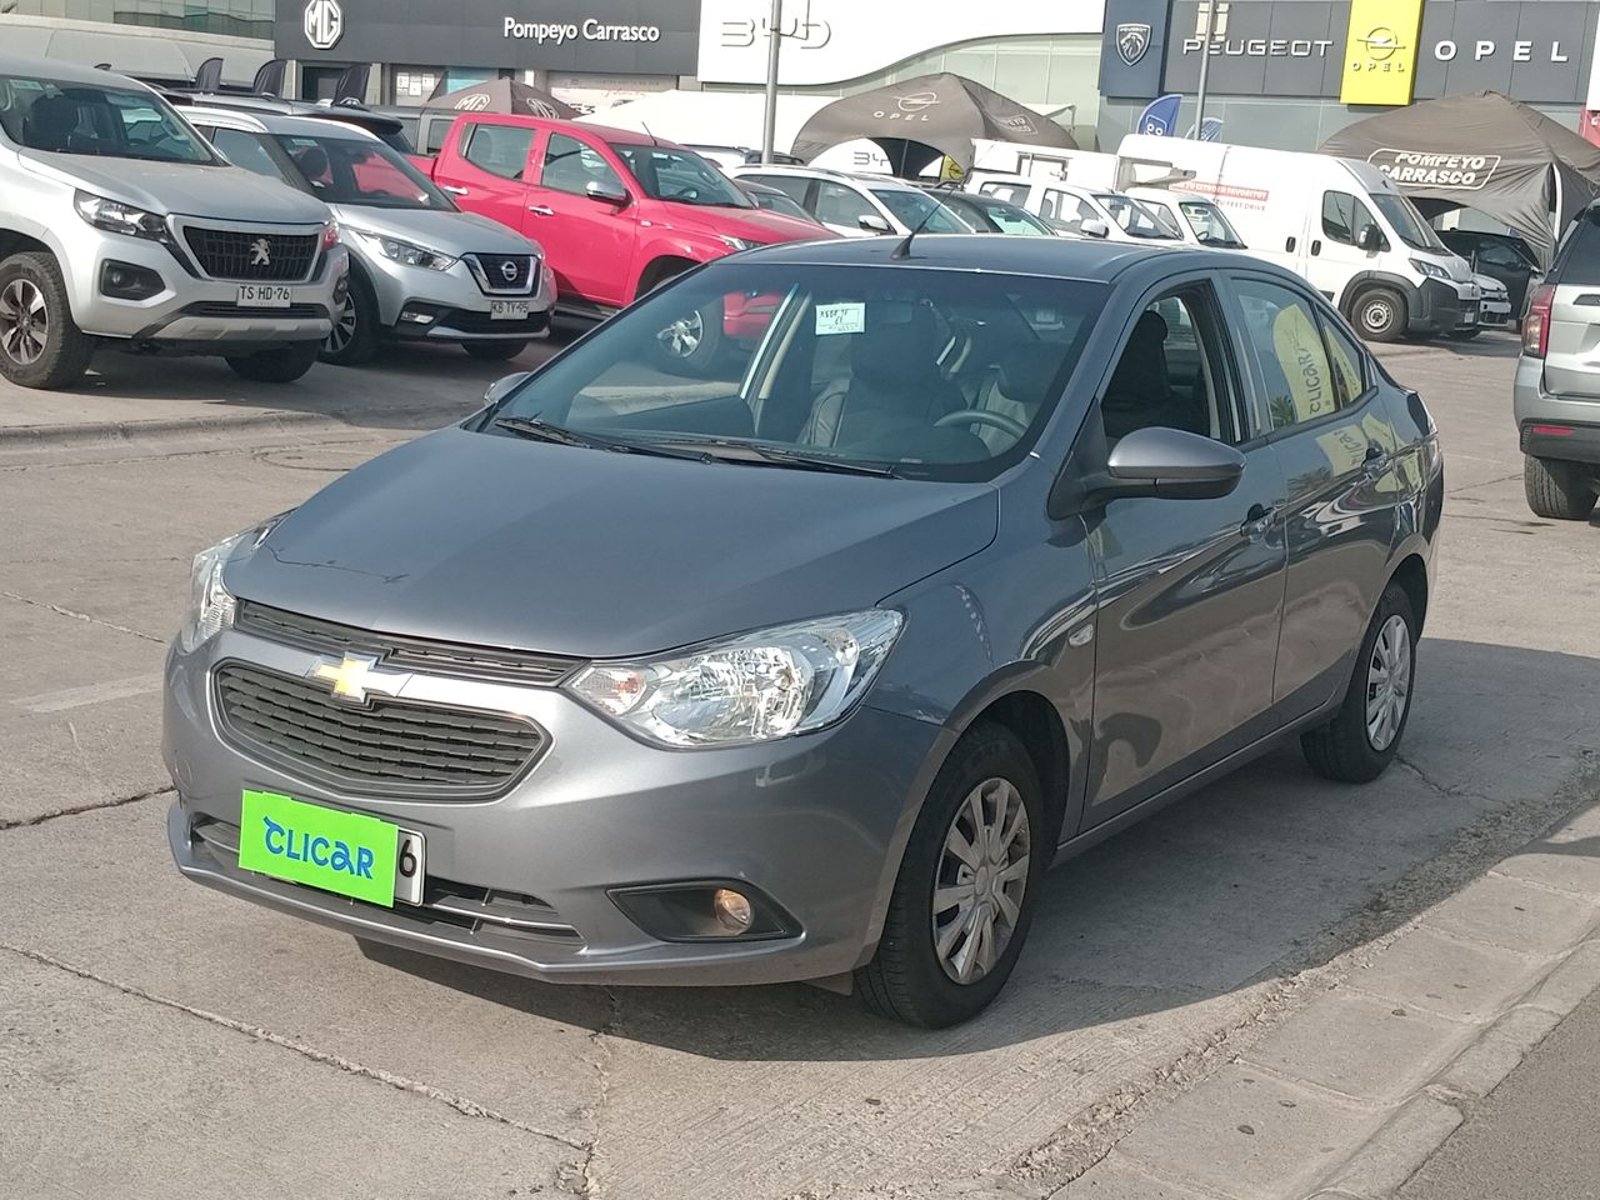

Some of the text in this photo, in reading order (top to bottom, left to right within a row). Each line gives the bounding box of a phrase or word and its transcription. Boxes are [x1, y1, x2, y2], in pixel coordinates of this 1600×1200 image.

[308, 1, 343, 46] MG
[503, 17, 661, 45] Pompeyo Carrasco
[1182, 39, 1334, 57] PEUGEOT
[1434, 40, 1569, 62] OPEL
[1352, 62, 1406, 73] OPEL
[454, 94, 490, 112] MG
[873, 111, 929, 122] OPEL
[1394, 153, 1486, 170] POMPEYO
[240, 286, 254, 300] TS
[399, 839, 417, 878] 6
